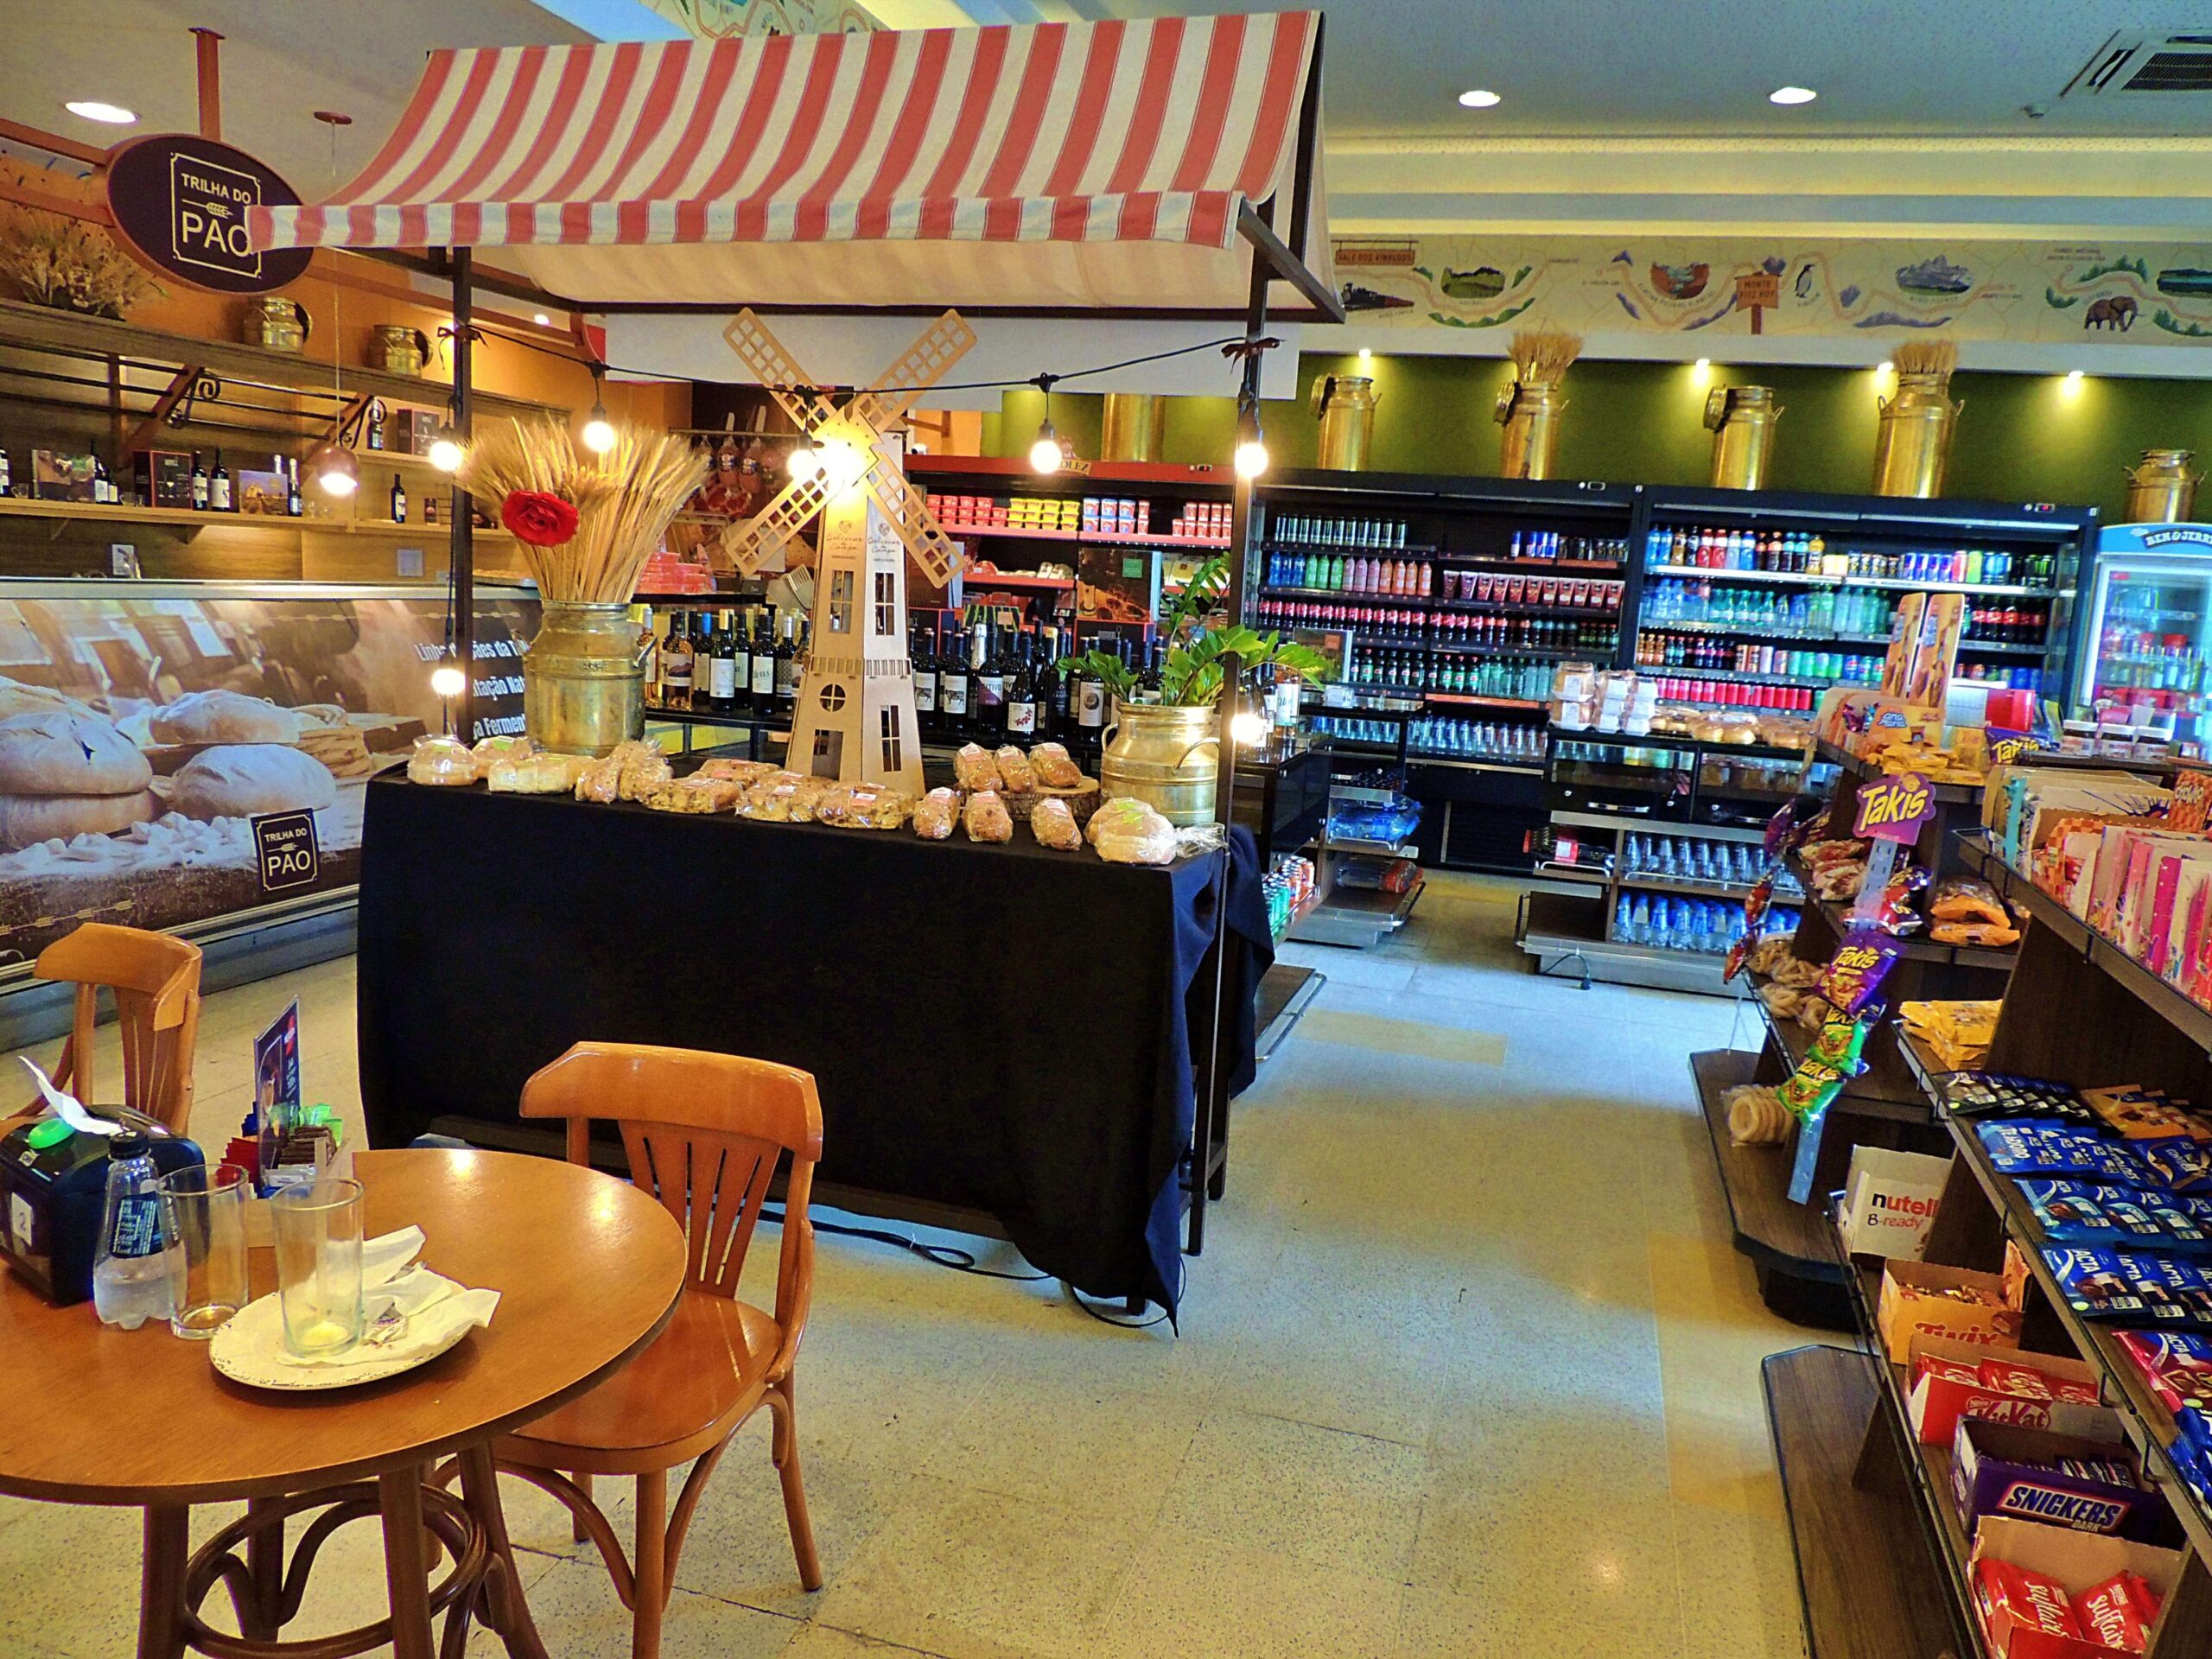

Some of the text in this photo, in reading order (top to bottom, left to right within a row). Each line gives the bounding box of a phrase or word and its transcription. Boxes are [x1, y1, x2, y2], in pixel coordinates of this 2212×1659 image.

[181, 173, 251, 205] TRILHA DO
[1744, 279, 1771, 289] MONTE
[494, 640, 512, 657] da
[505, 675, 525, 694] Nat
[1859, 785, 1929, 831] Takis
[264, 827, 308, 842] TRILHA DO
[1834, 946, 1880, 969] Takis
[1872, 1192, 1940, 1218] nutell
[1867, 1212, 1924, 1231] B-ready
[2072, 1249, 2101, 1274] LACTA
[2117, 1255, 2143, 1281] LACTA
[2158, 1260, 2185, 1287] LACTA
[2005, 1485, 2122, 1527] SNICKERS
